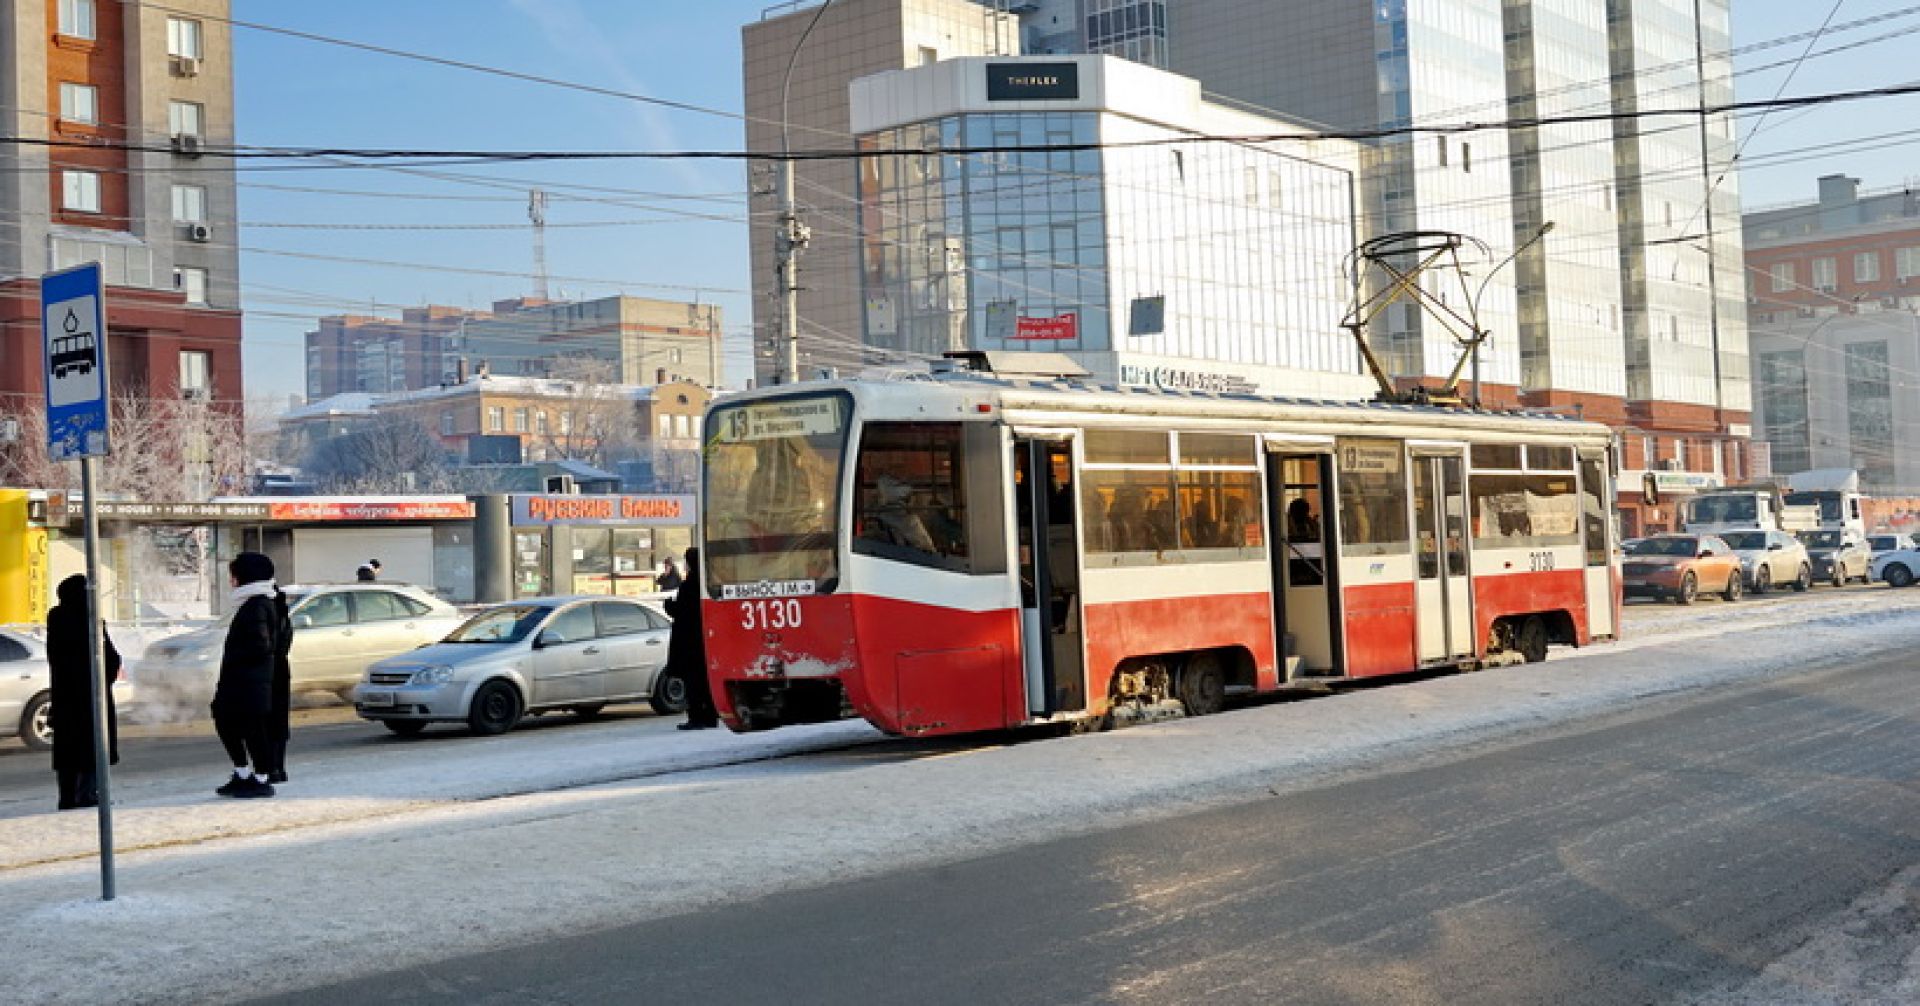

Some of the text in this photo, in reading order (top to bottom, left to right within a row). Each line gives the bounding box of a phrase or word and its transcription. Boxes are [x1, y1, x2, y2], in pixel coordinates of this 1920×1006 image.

[729, 410, 748, 439] 13
[529, 496, 614, 521] Русские
[741, 599, 801, 630] 3130
